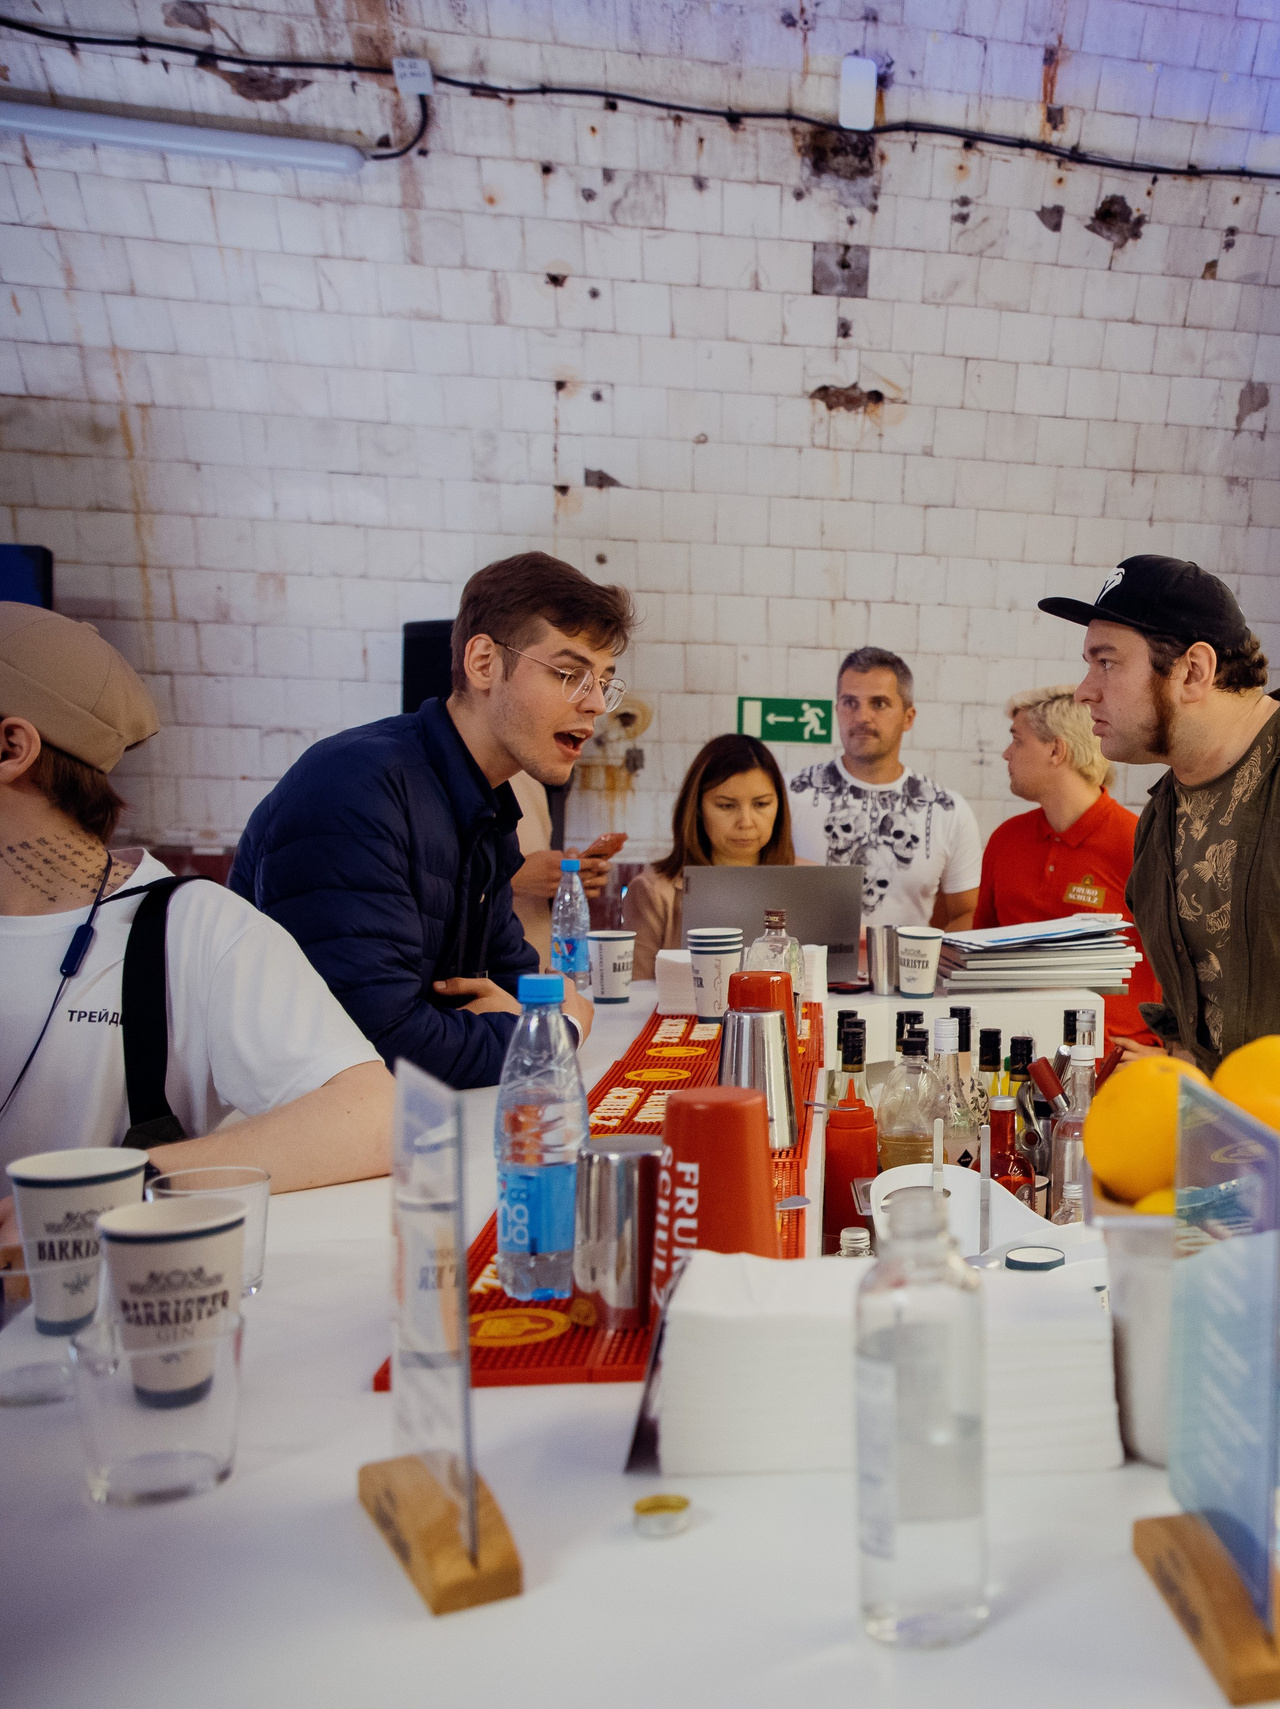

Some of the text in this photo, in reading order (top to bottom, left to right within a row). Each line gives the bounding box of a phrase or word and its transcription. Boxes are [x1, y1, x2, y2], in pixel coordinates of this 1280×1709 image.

[68, 1008, 122, 1027] ТРЕЙД
[37, 1239, 100, 1261] BARRIS
[121, 1290, 229, 1326] BARRISTER
